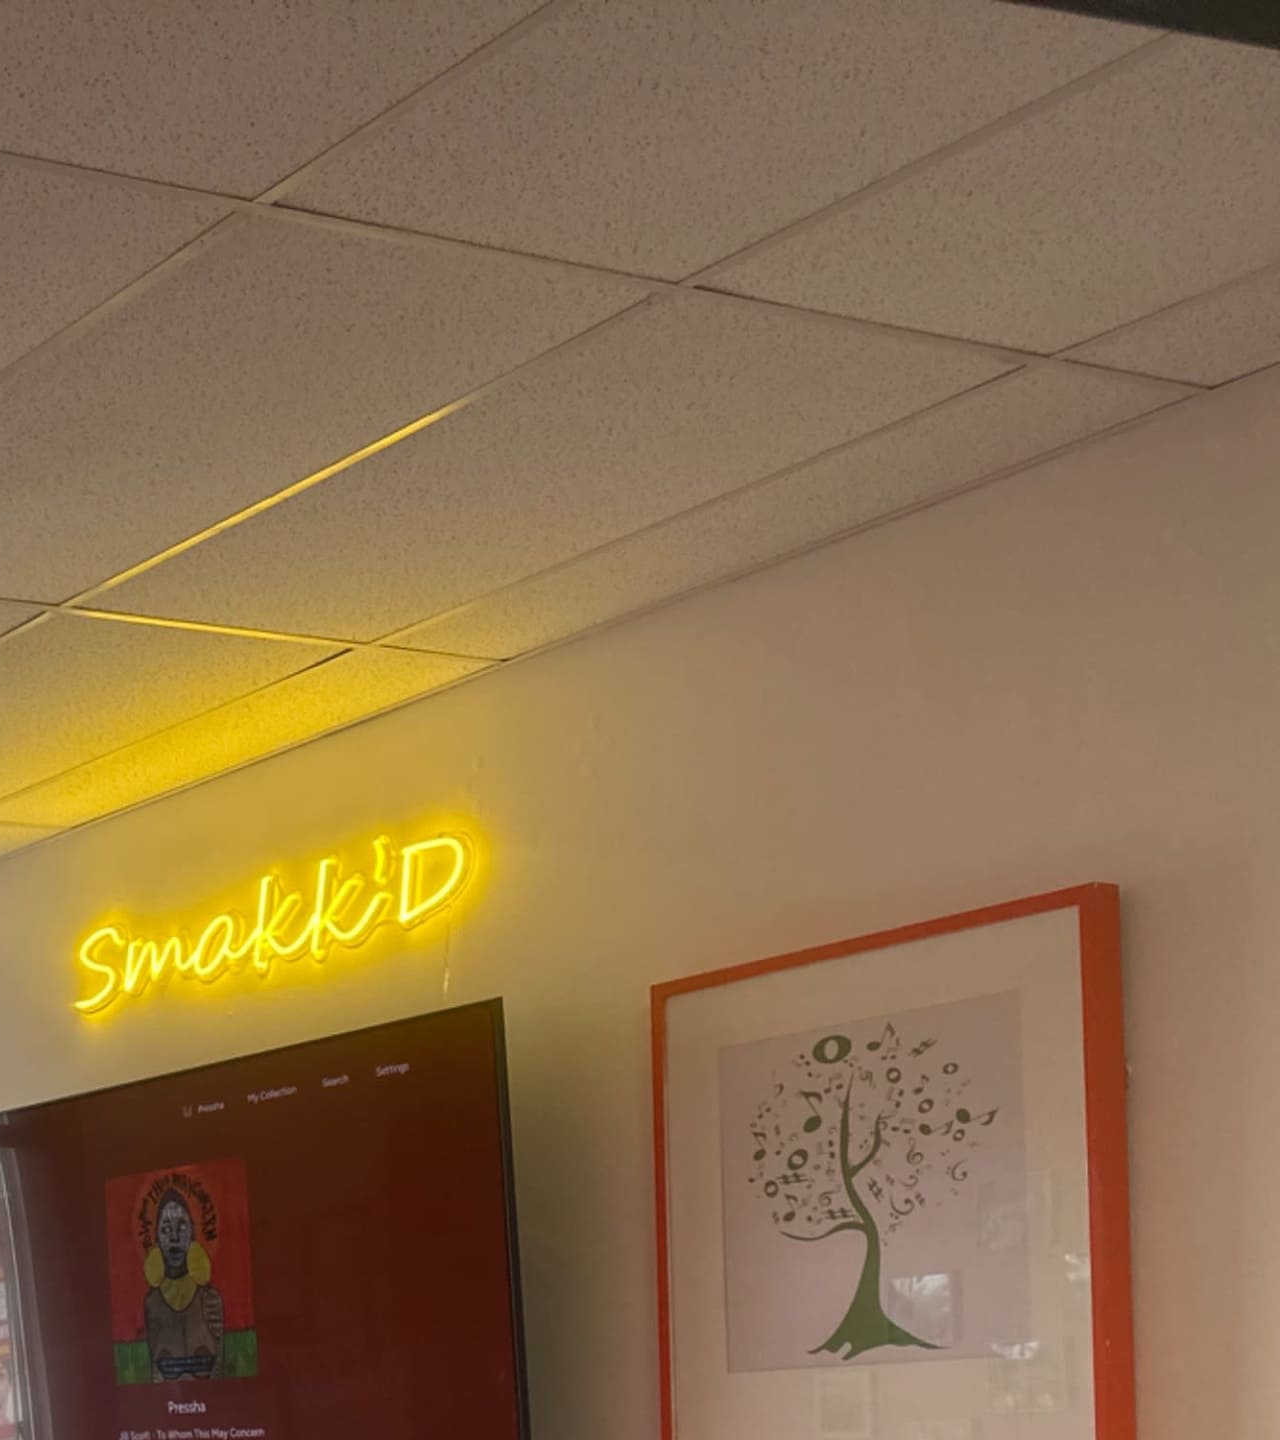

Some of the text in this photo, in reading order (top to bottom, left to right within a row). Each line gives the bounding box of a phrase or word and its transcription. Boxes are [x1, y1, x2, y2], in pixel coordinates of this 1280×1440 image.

[375, 1062, 410, 1078] Settings
[321, 1074, 349, 1088] Search
[247, 1085, 298, 1104] My Collection
[167, 1400, 206, 1415] Pressha
[130, 1430, 151, 1440] Scott
[155, 1429, 166, 1440] To
[167, 1429, 193, 1440] Whom
[193, 1428, 210, 1439] This
[210, 1427, 229, 1440] May
[229, 1426, 265, 1438] Concern
